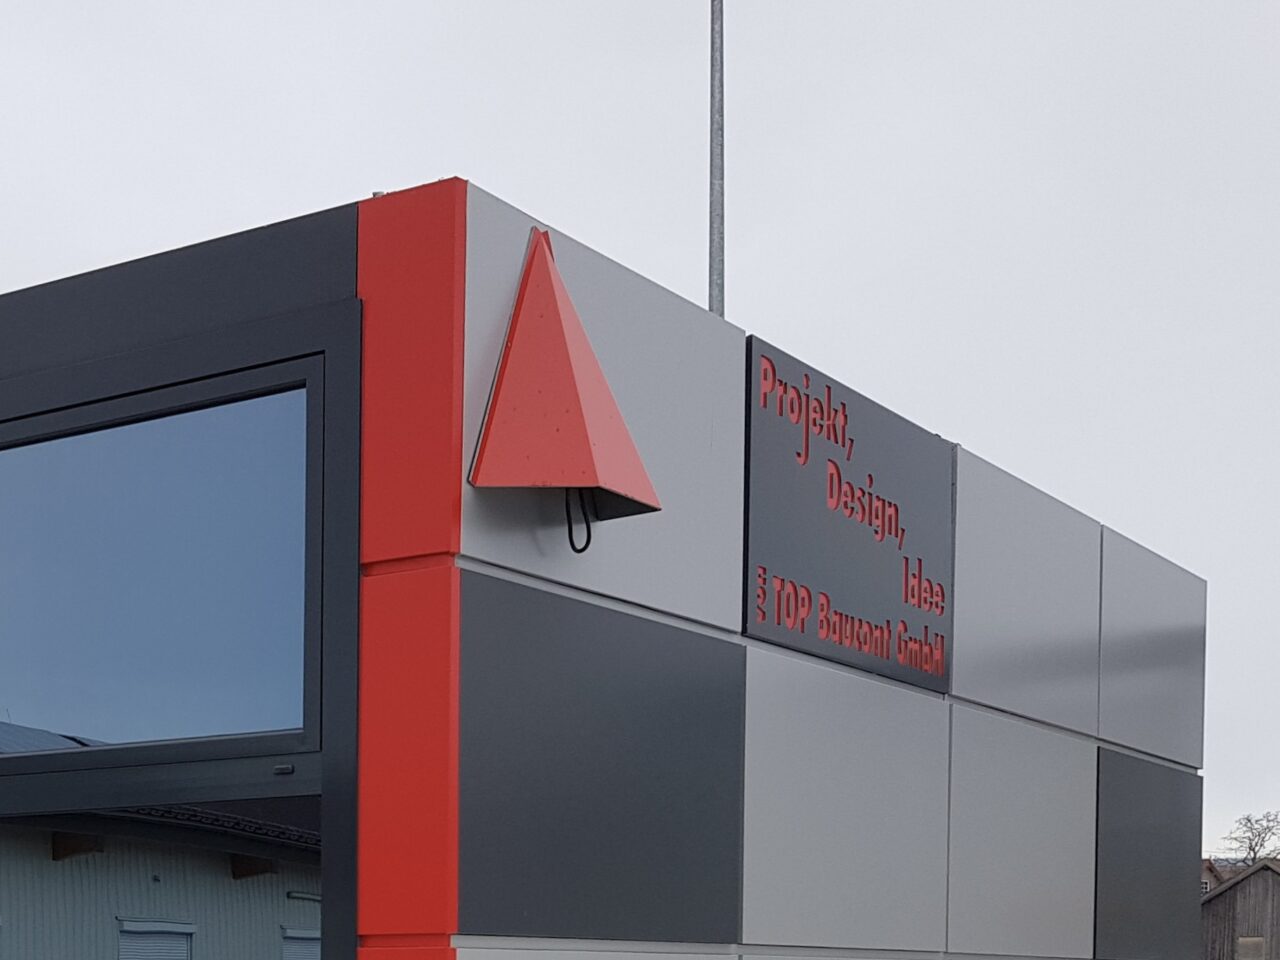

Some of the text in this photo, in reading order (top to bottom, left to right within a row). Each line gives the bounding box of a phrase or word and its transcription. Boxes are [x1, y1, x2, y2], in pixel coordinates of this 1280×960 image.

[759, 354, 855, 466] Projekt,
[827, 458, 906, 550] Design,
[773, 575, 945, 677] TOP Baucont GmbH
[903, 556, 945, 616] Idee
